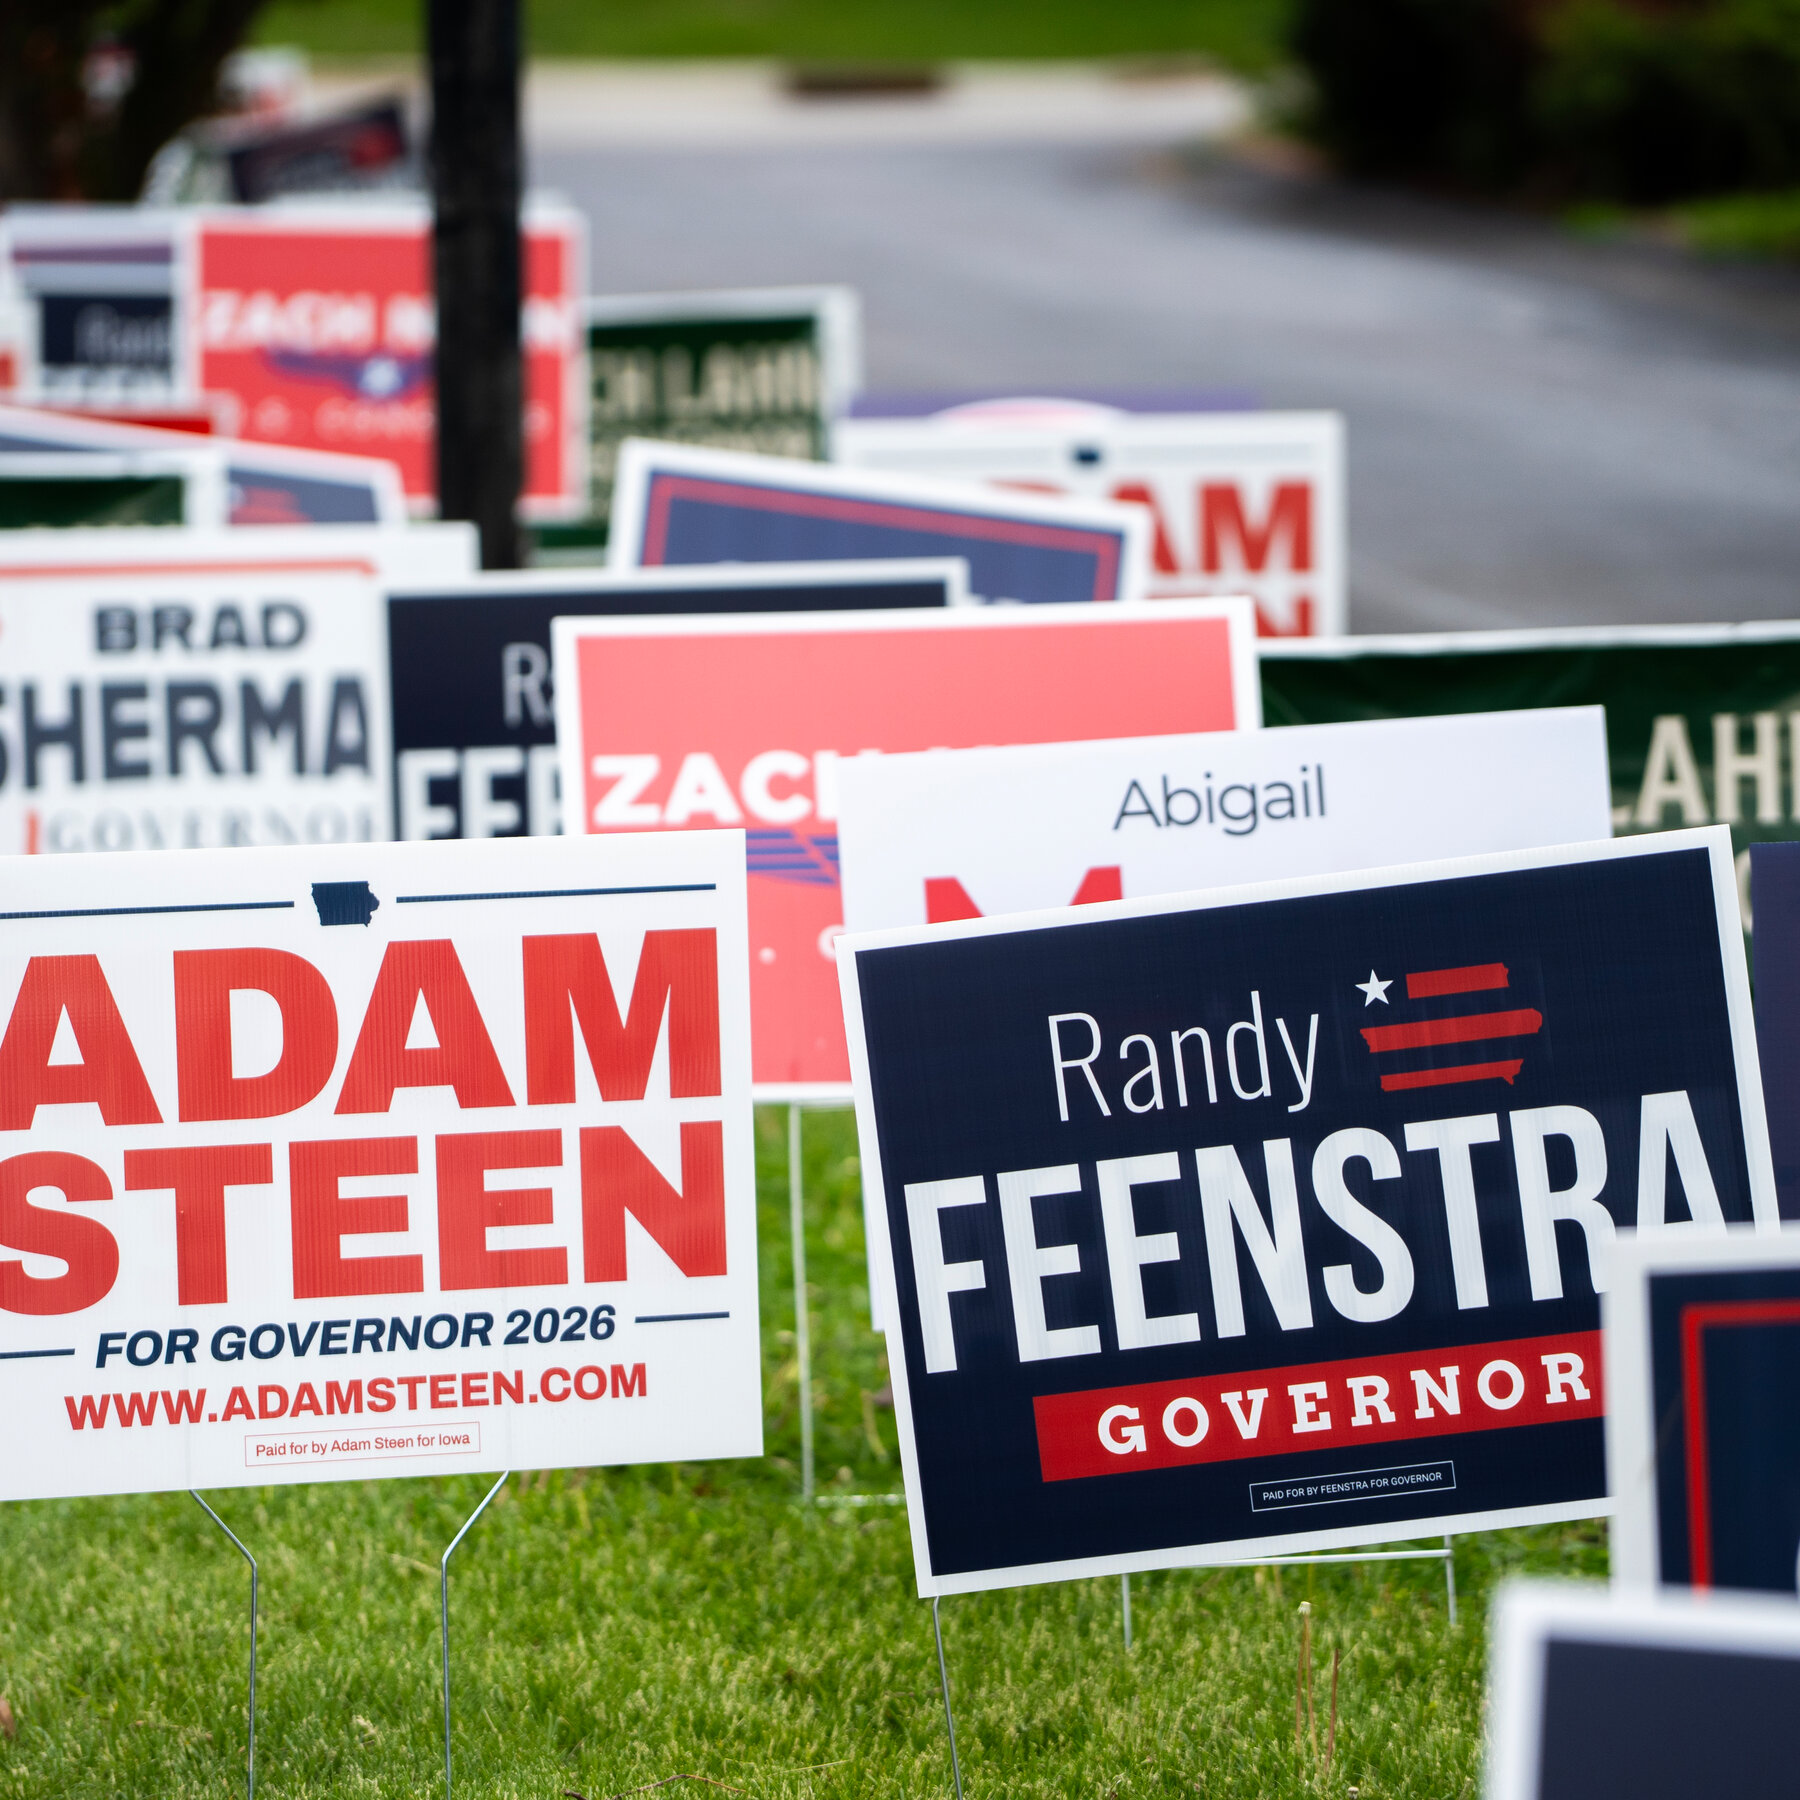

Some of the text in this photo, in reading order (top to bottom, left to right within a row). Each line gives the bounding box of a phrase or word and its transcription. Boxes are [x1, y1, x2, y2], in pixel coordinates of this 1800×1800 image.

[94, 603, 308, 655] BRAD
[0, 672, 370, 792] HERMA
[1112, 763, 1326, 838] Abigail
[0, 927, 722, 1131] ADAM
[1047, 990, 1320, 1122] Randy
[0, 1120, 728, 1316] STEEN
[903, 1089, 1728, 1374] FEENSTRA
[95, 1304, 616, 1368] FOR GOVERNOR 2026
[64, 1362, 648, 1431] WWW.ADAMSTEEN.COM
[1097, 1352, 1592, 1455] GOVERNOR
[255, 1431, 471, 1457] Paid for by Adam Steen for Iowa
[1262, 1471, 1443, 1501] PAID FOR BY FEENSTRA FOR GOVERNOR
